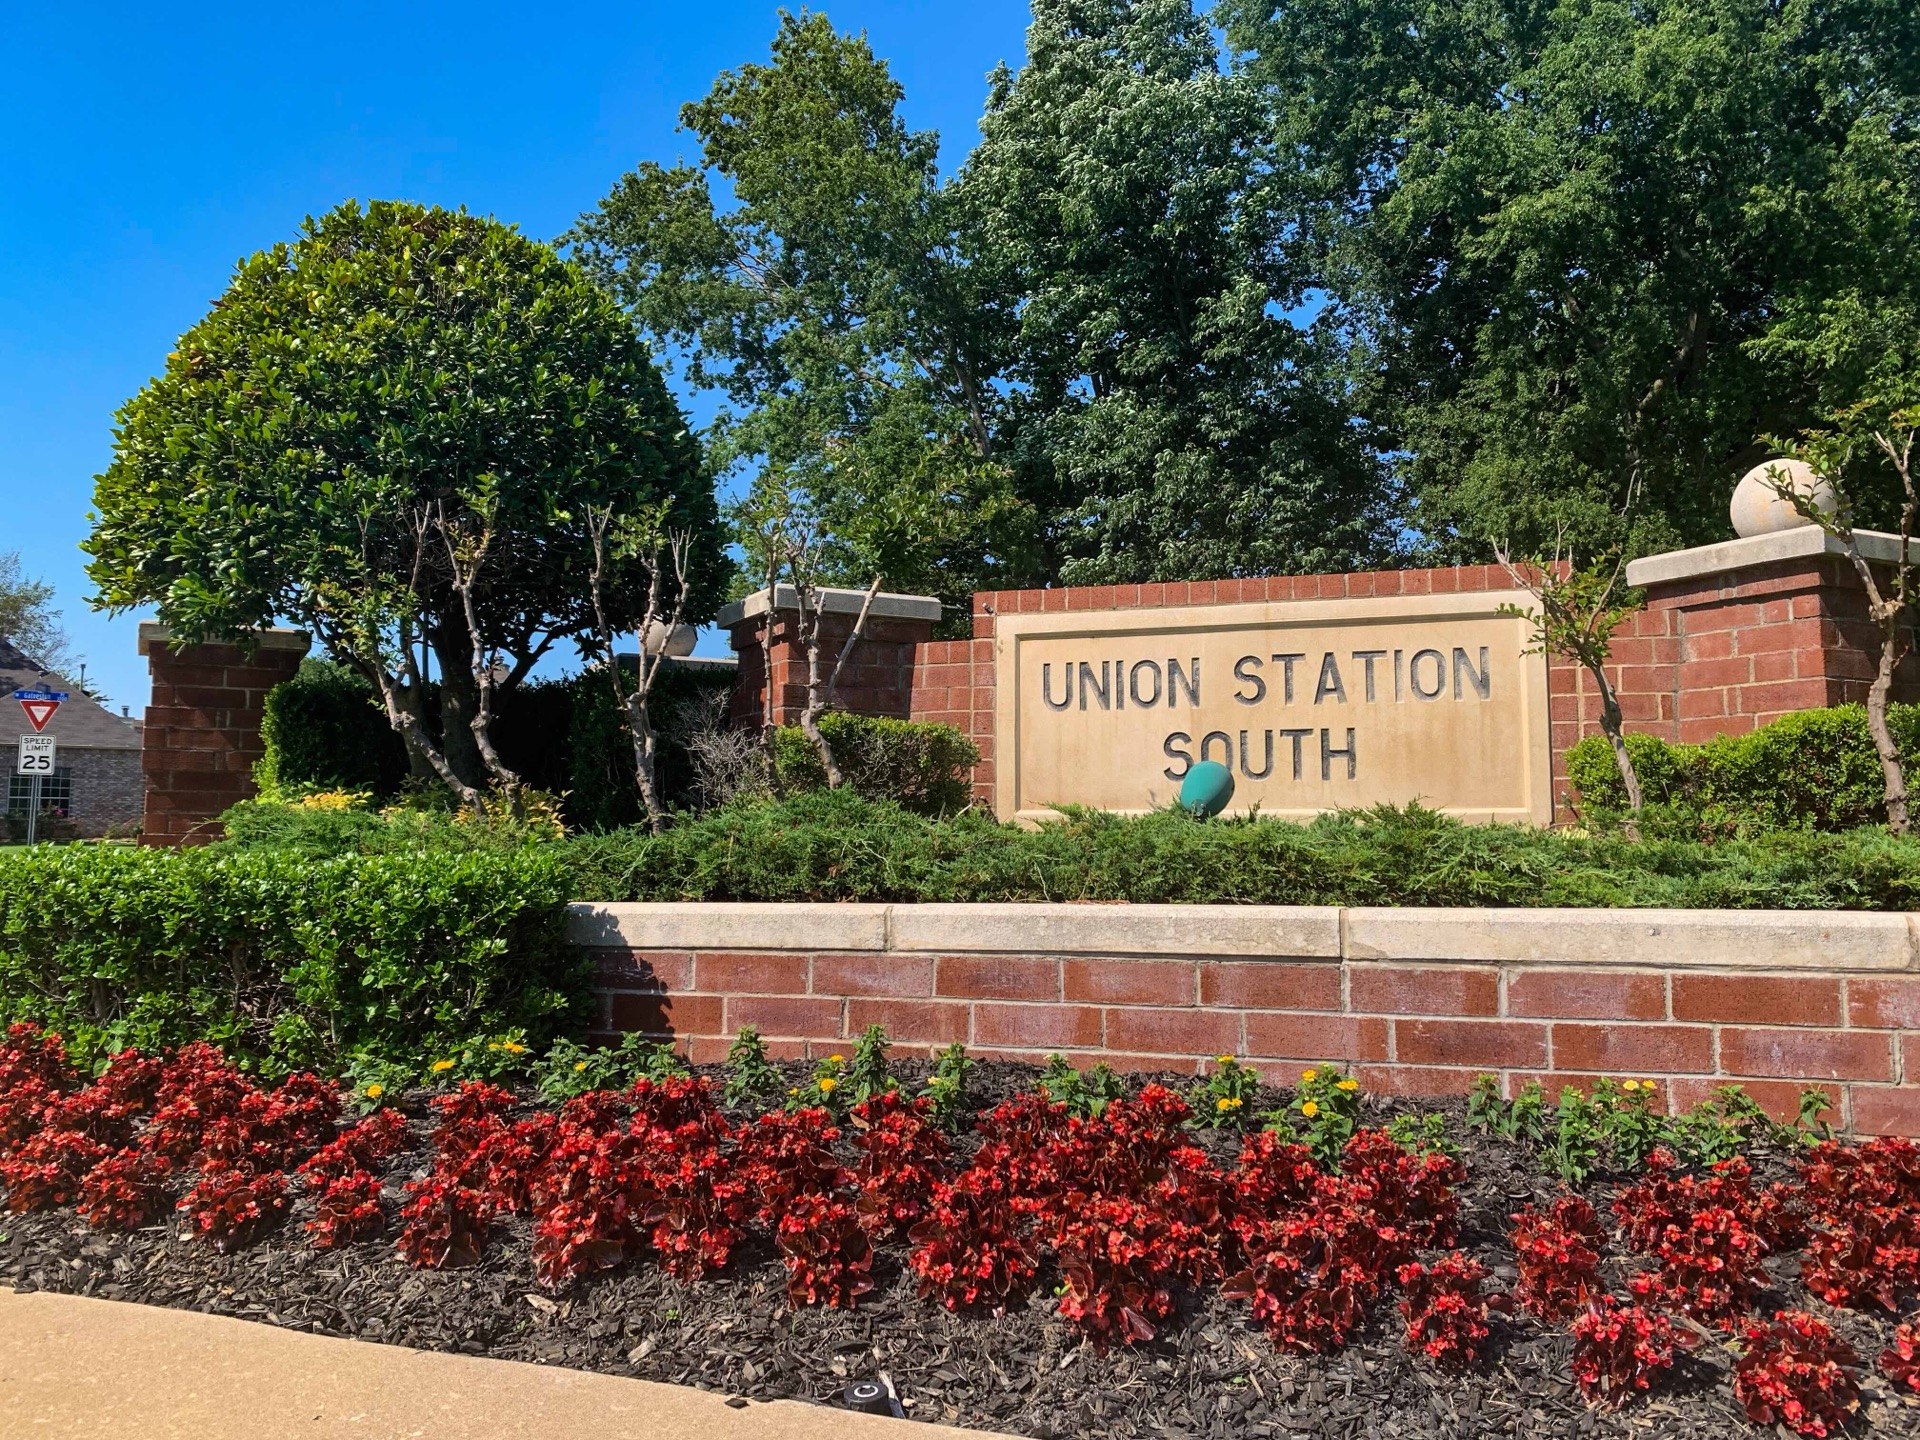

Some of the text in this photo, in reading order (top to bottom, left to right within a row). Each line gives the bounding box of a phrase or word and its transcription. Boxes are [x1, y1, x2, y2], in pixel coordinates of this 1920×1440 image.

[1042, 645, 1491, 712] UNION STATION
[22, 755, 51, 770] 25
[1163, 727, 1357, 782] SOUTH
